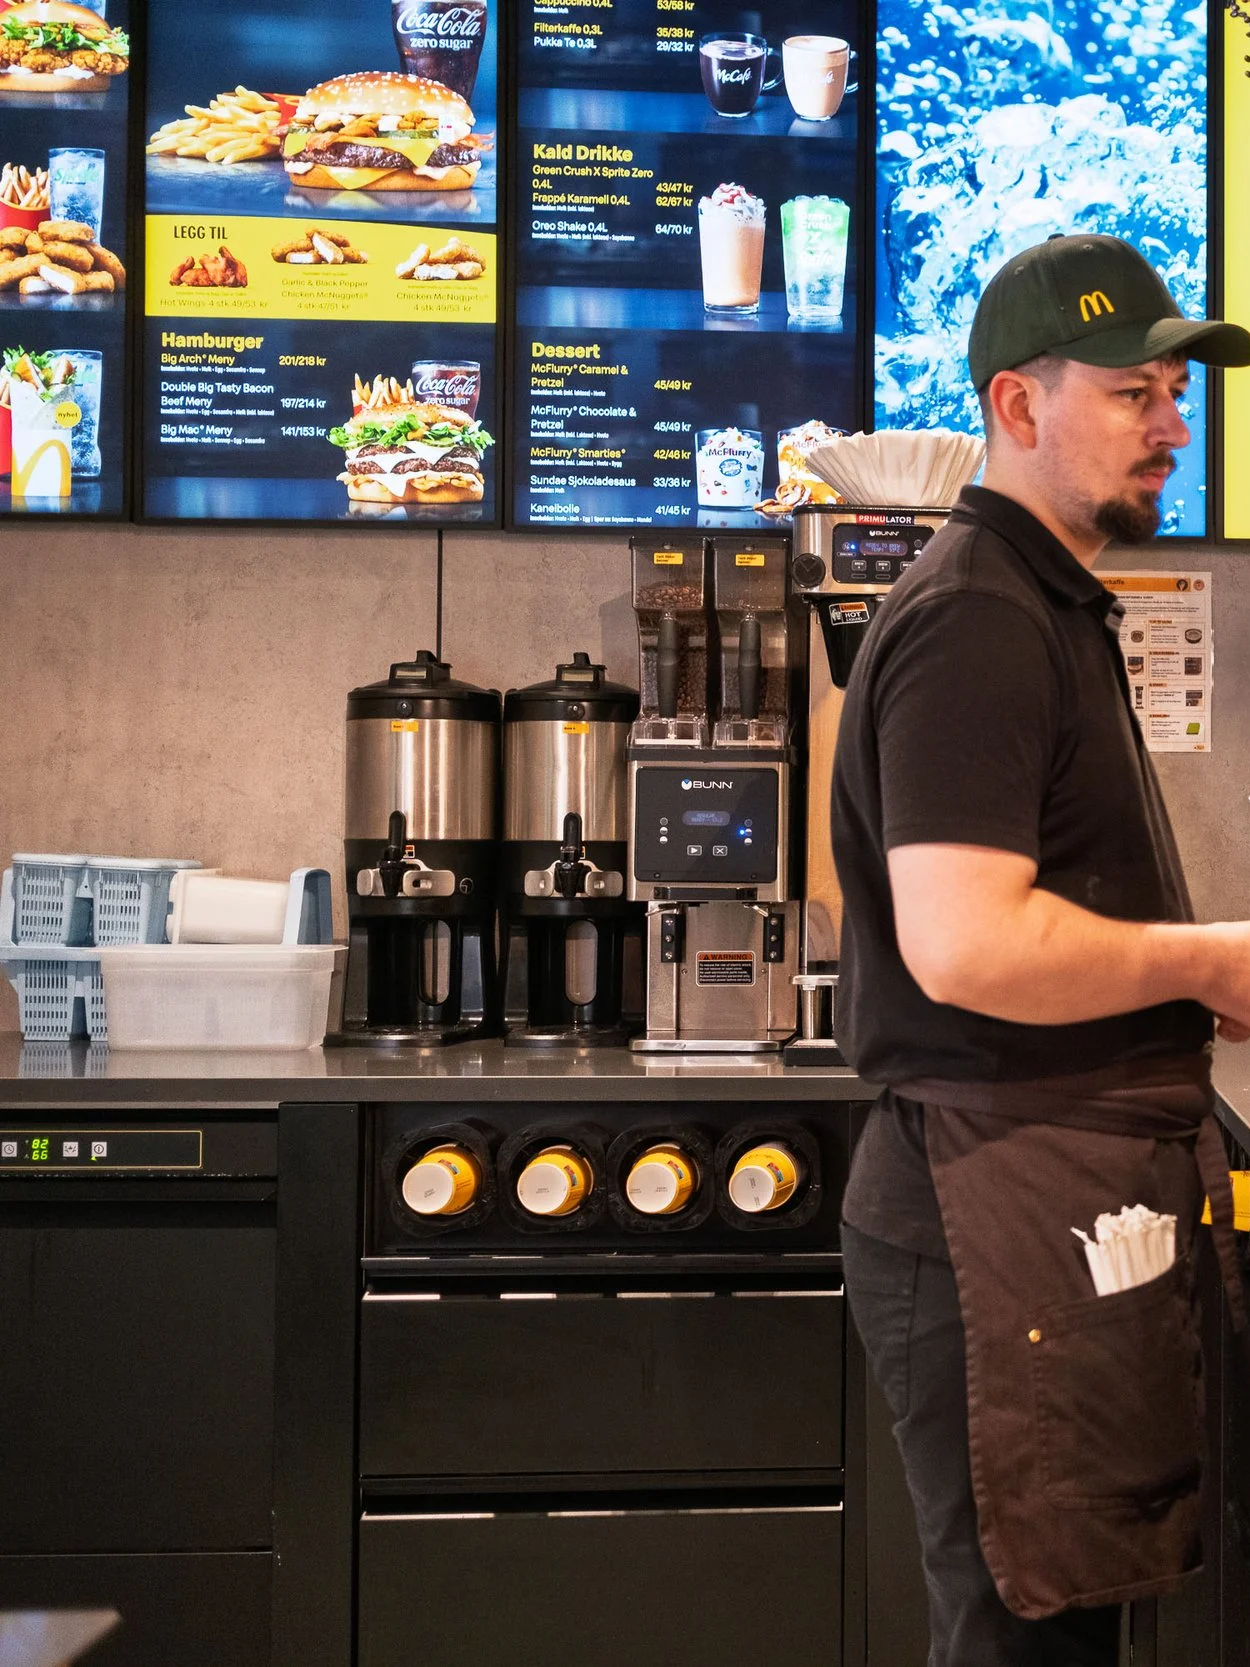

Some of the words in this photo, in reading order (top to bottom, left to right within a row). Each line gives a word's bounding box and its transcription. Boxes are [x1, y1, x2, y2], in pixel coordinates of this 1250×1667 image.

[685, 1, 694, 11] kr
[396, 7, 485, 37] Coca-Cola
[534, 23, 581, 34] Filterkaffe
[583, 24, 603, 35] 0,3L
[657, 28, 683, 37] 35/38
[685, 28, 694, 38] kr
[410, 38, 438, 48] zero
[439, 39, 474, 51] sugar
[534, 37, 563, 47] Pukka
[564, 37, 576, 47] Te
[577, 38, 597, 49] 0,3L
[656, 41, 683, 51] 29/32
[685, 42, 694, 52] kr
[533, 144, 572, 160] Kald
[576, 145, 634, 162] Drikke
[533, 165, 562, 175] Green
[563, 166, 591, 177] Crush
[593, 167, 601, 176] X
[602, 167, 630, 179] Sprite
[631, 168, 654, 178] Zero
[532, 179, 553, 189] 0,4L
[656, 183, 682, 193] 43/47
[683, 183, 693, 193] kr
[533, 192, 565, 205] Frappé
[567, 194, 609, 204] Karamell
[610, 195, 631, 205] 0,4L
[656, 196, 682, 206] 62/67
[683, 197, 693, 207] kr
[174, 225, 205, 239] LEGG
[209, 226, 228, 239] TIL
[532, 220, 556, 231] Oreo
[557, 221, 587, 232] Shake
[588, 222, 608, 233] 0,4L
[655, 224, 682, 234] 64/70
[683, 224, 693, 235] kr
[307, 279, 313, 287] &
[316, 279, 337, 287] Black
[339, 281, 368, 290] Pepper
[396, 292, 432, 300] Chicken
[160, 299, 176, 307] Hot
[178, 300, 205, 309] Wings
[216, 299, 229, 307] stk
[161, 332, 264, 352] Hamburger
[532, 342, 600, 359] Dessert
[161, 354, 177, 365] Big
[208, 355, 235, 366] Meny
[279, 356, 315, 366] 201/218
[316, 356, 327, 366] kr
[579, 364, 619, 375] Caramel
[621, 365, 629, 375] &
[161, 382, 196, 392] Double
[198, 383, 213, 394] Big
[215, 383, 242, 395] Tasty
[243, 384, 274, 393] Bacon
[416, 374, 479, 396] Coca-Cola
[531, 377, 564, 387] Pretzel
[654, 380, 680, 390] 45/49
[682, 380, 692, 390] kr
[161, 396, 184, 406] Beef
[185, 397, 212, 408] Meny
[280, 398, 315, 408] 197/214
[316, 398, 326, 408] kr
[425, 397, 445, 405] zero
[446, 398, 470, 406] sugar
[578, 406, 627, 417] Chocolate
[629, 407, 637, 417] &
[161, 425, 177, 436] Big
[206, 425, 233, 437] Meny
[281, 426, 315, 436] 141/153
[316, 427, 326, 437] kr
[531, 419, 564, 429] Pretzel
[654, 421, 680, 432] 45/49
[681, 421, 692, 432] kr
[653, 449, 680, 460] 42/46
[681, 450, 692, 460] kr
[530, 475, 566, 486] Sundae
[568, 476, 636, 487] Sjokoladesaus
[653, 477, 680, 488] 33/36
[681, 477, 692, 488] kr
[530, 503, 580, 514] Kanelbolle
[655, 505, 680, 515] 41/45
[681, 505, 692, 515] kr
[859, 515, 912, 524] PRIMULATOR
[693, 781, 733, 789] BUNN
[32, 1139, 49, 1149] 82
[32, 1150, 48, 1160] 66
